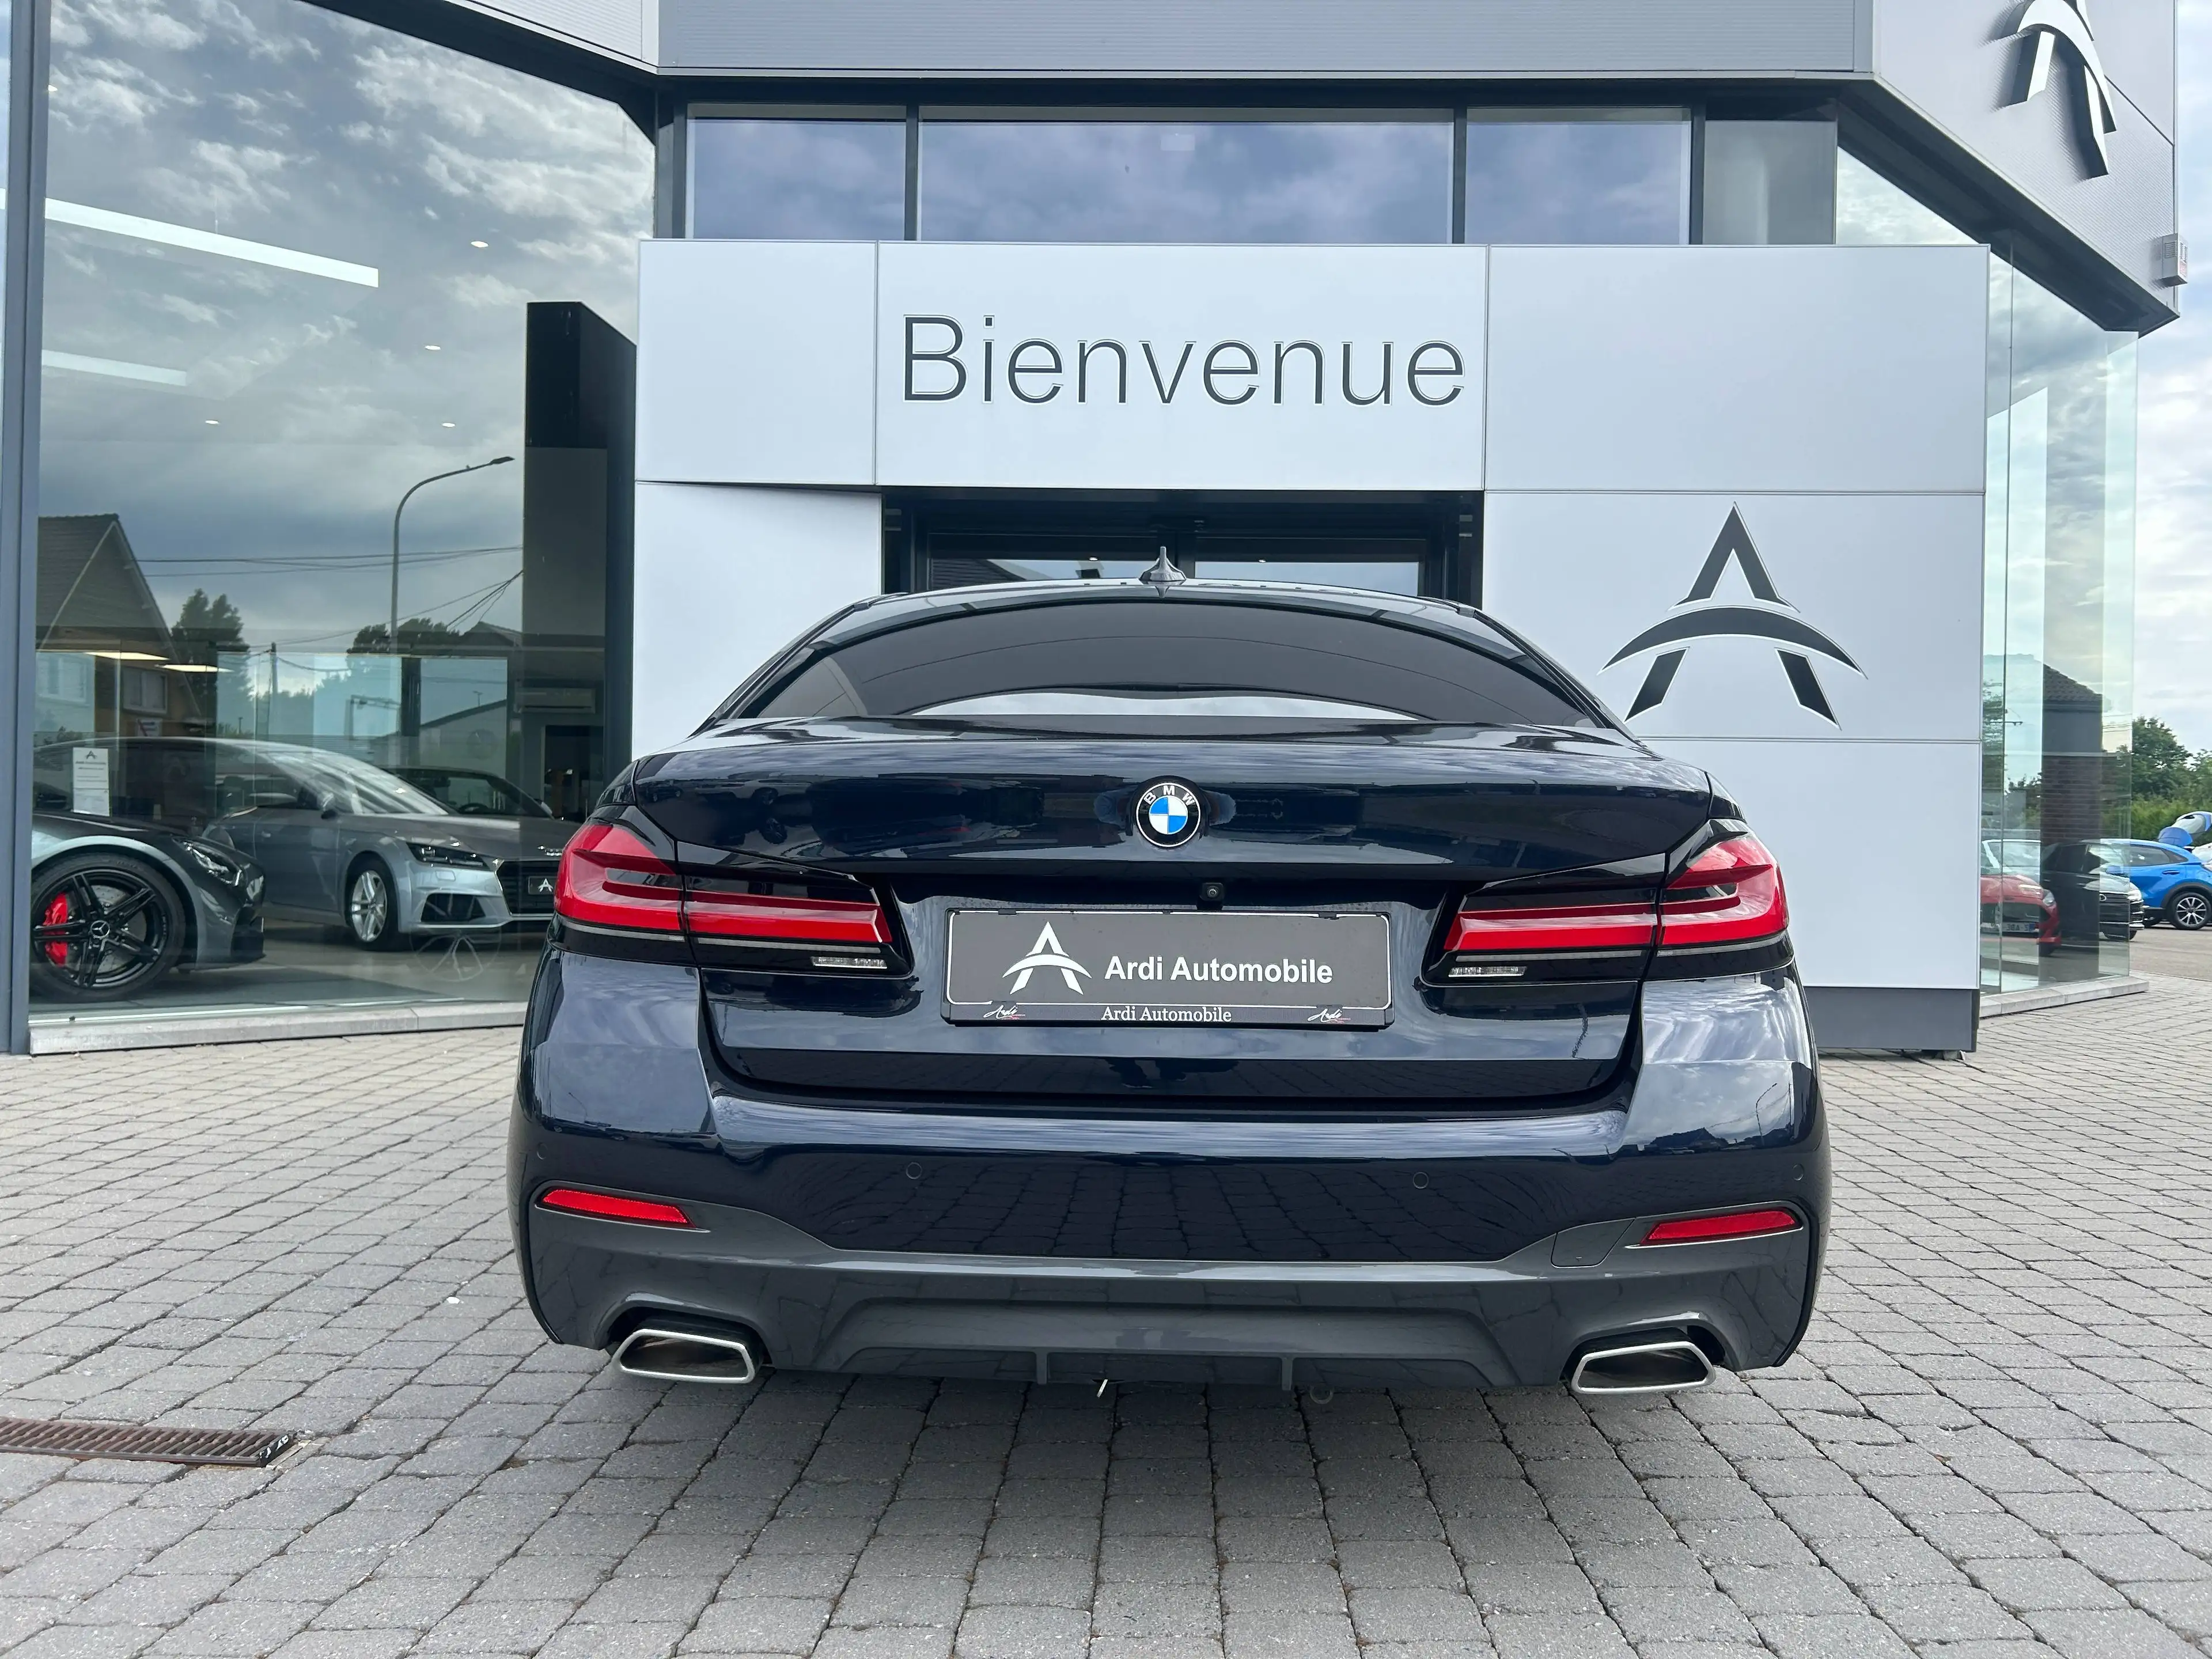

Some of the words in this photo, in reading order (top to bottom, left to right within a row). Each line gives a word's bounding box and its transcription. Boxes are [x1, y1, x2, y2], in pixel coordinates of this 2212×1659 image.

[903, 315, 1465, 406] Bienvenue
[1143, 785, 1196, 805] BMW
[1104, 956, 1162, 980] Ardi
[1171, 956, 1334, 983] Automobile
[983, 1005, 1018, 1019] Ardi
[1101, 1006, 1136, 1021] Ardi
[1139, 1006, 1232, 1022] Automobile
[1307, 1008, 1343, 1022] Ardi
